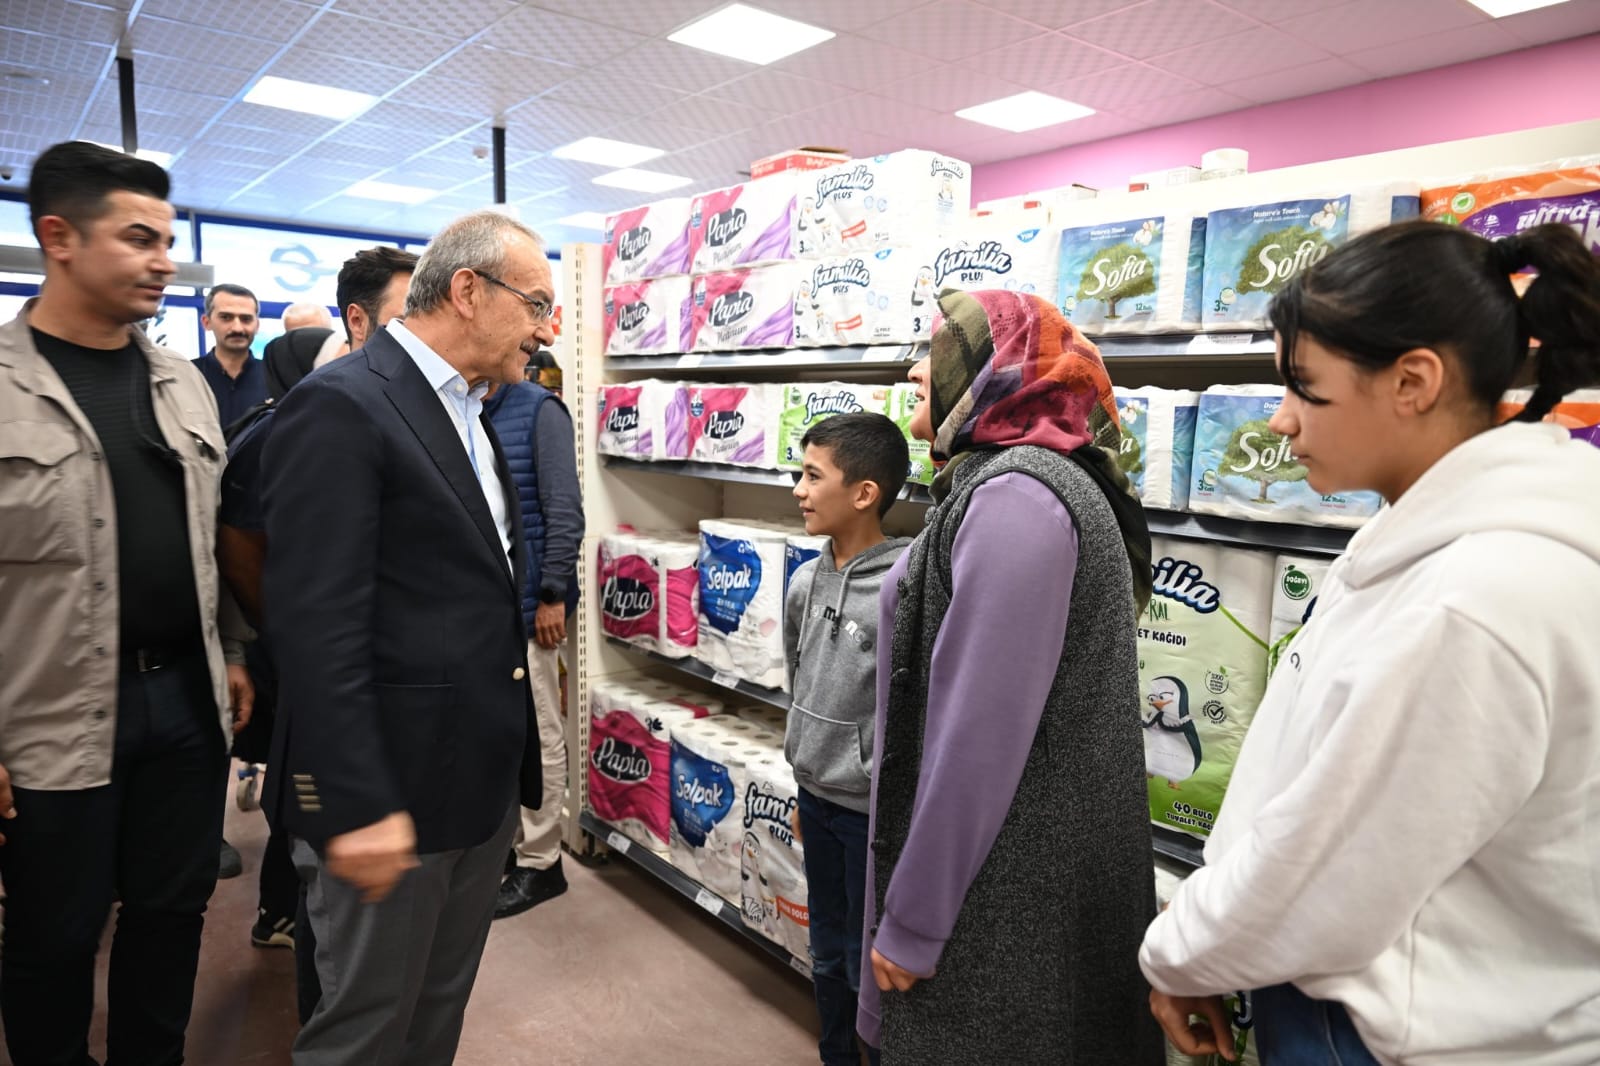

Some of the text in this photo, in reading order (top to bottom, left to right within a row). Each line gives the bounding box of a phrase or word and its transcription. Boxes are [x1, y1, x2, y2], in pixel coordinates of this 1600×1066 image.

[816, 164, 874, 209] familia
[833, 191, 853, 201] PLUS
[705, 208, 747, 246] Papia
[617, 227, 651, 261] Papia
[811, 258, 871, 299] familia
[935, 241, 1012, 288] familia
[1084, 255, 1148, 297] Sofia
[1249, 240, 1328, 290] Sofia
[617, 301, 651, 331] Papia
[709, 291, 754, 327] Papia
[1135, 303, 1144, 311] 12
[1213, 299, 1221, 312] 3
[913, 317, 921, 333] 3
[607, 406, 640, 433] Papi
[705, 410, 744, 440] Papia
[787, 447, 793, 460] 3
[1231, 432, 1297, 472] Sofi
[1197, 480, 1204, 490] 3
[707, 564, 752, 595] Selpak
[602, 576, 654, 618] Papia
[1152, 630, 1187, 646] KAĞIDI
[598, 737, 651, 780] Papia
[676, 775, 723, 808] Selpak
[1174, 801, 1191, 814] 40
[769, 825, 794, 848] PLUS
